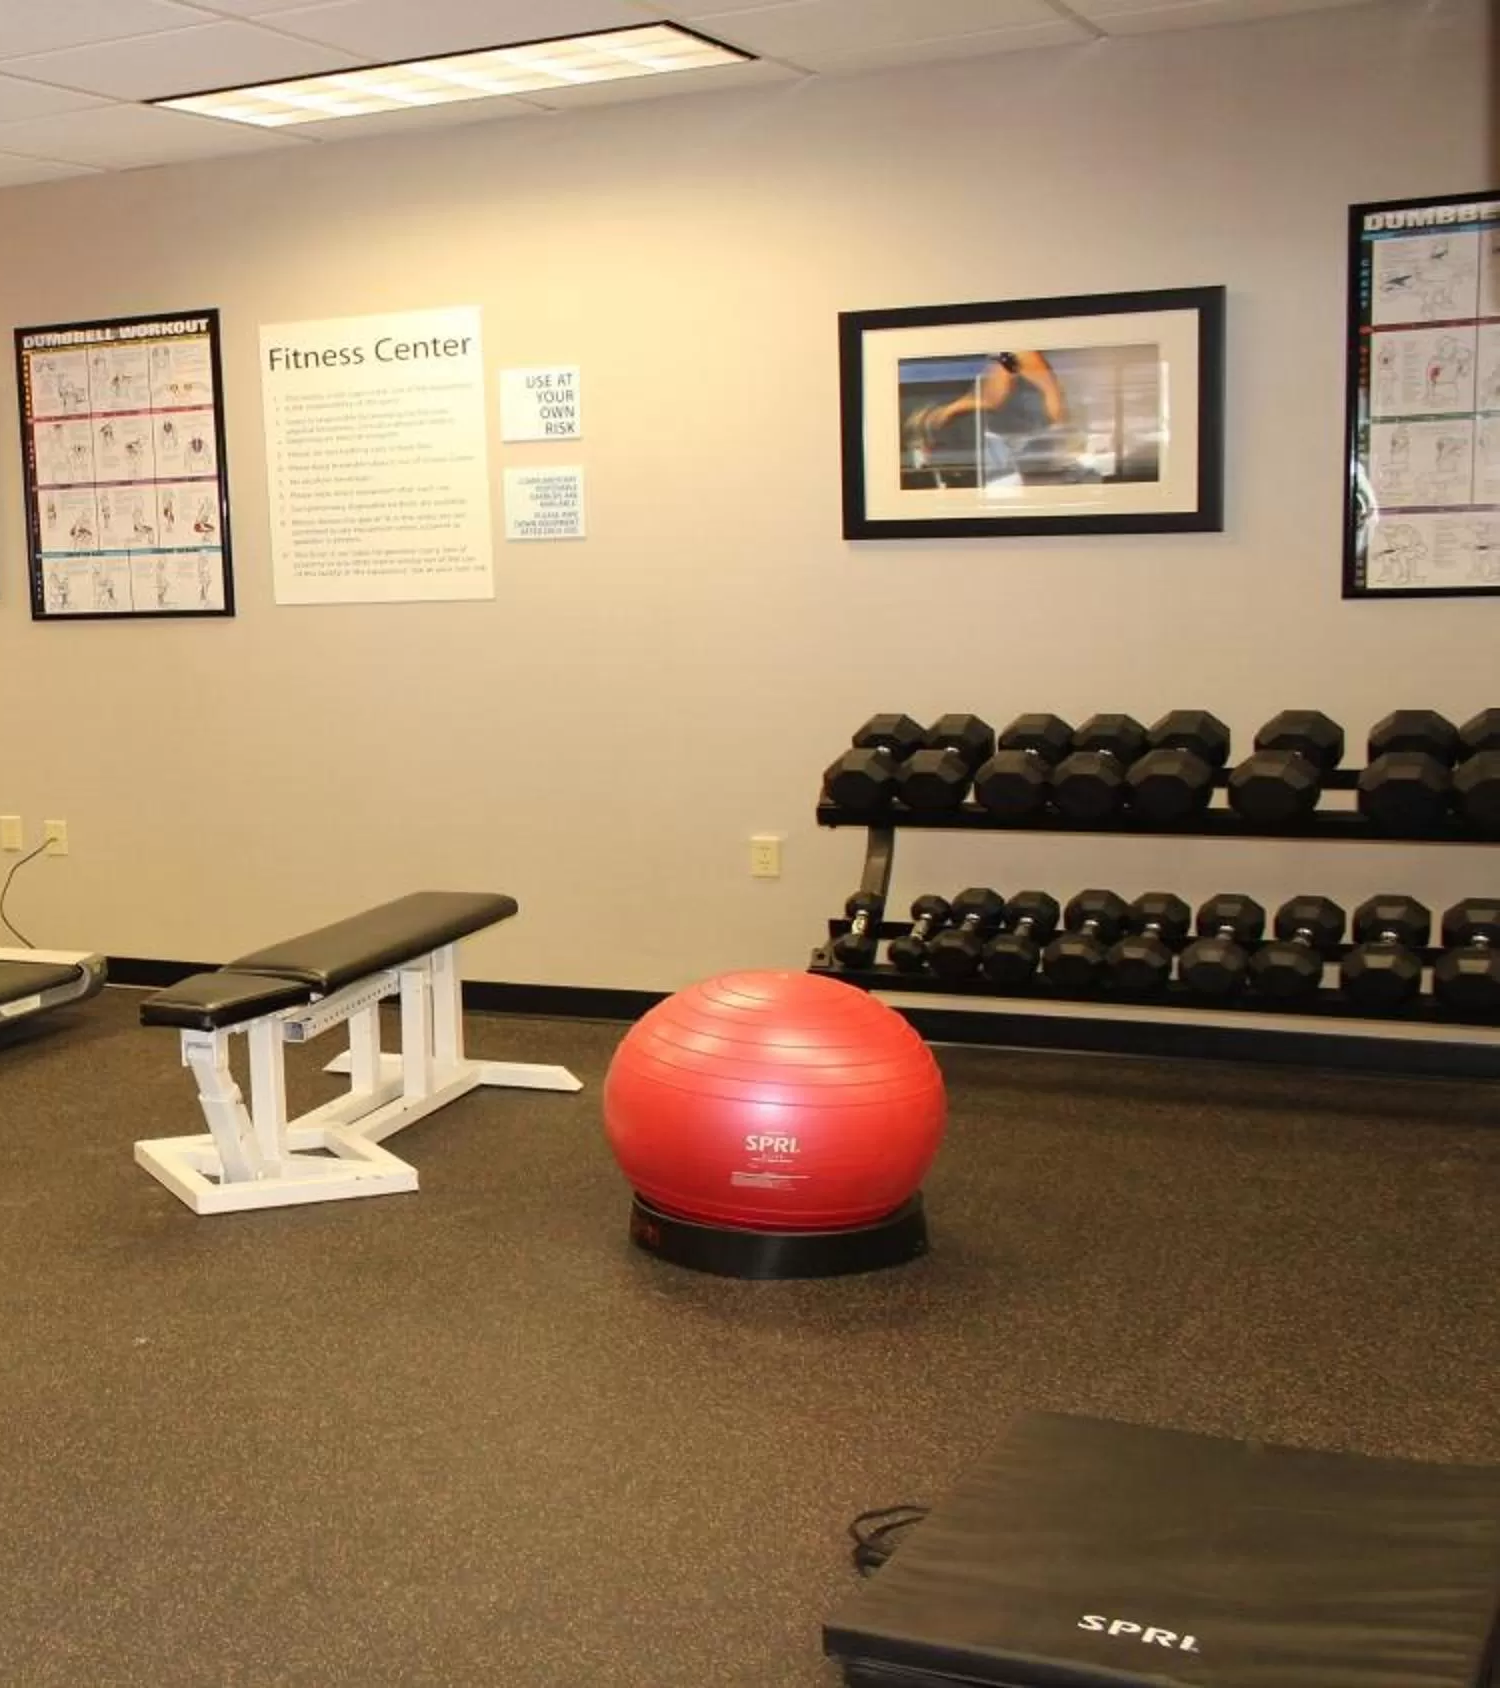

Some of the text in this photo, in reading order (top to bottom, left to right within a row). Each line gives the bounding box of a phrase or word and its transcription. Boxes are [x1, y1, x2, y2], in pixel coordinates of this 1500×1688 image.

[22, 318, 210, 348] DUMBBELL WORKOUT
[268, 337, 471, 371] Fitness Center
[525, 373, 573, 389] USE AT
[536, 389, 575, 404] YOUR
[539, 405, 575, 419] OWN
[545, 421, 576, 435] RISK
[745, 1135, 798, 1153] SPRI
[1077, 1615, 1196, 1651] SPRI
